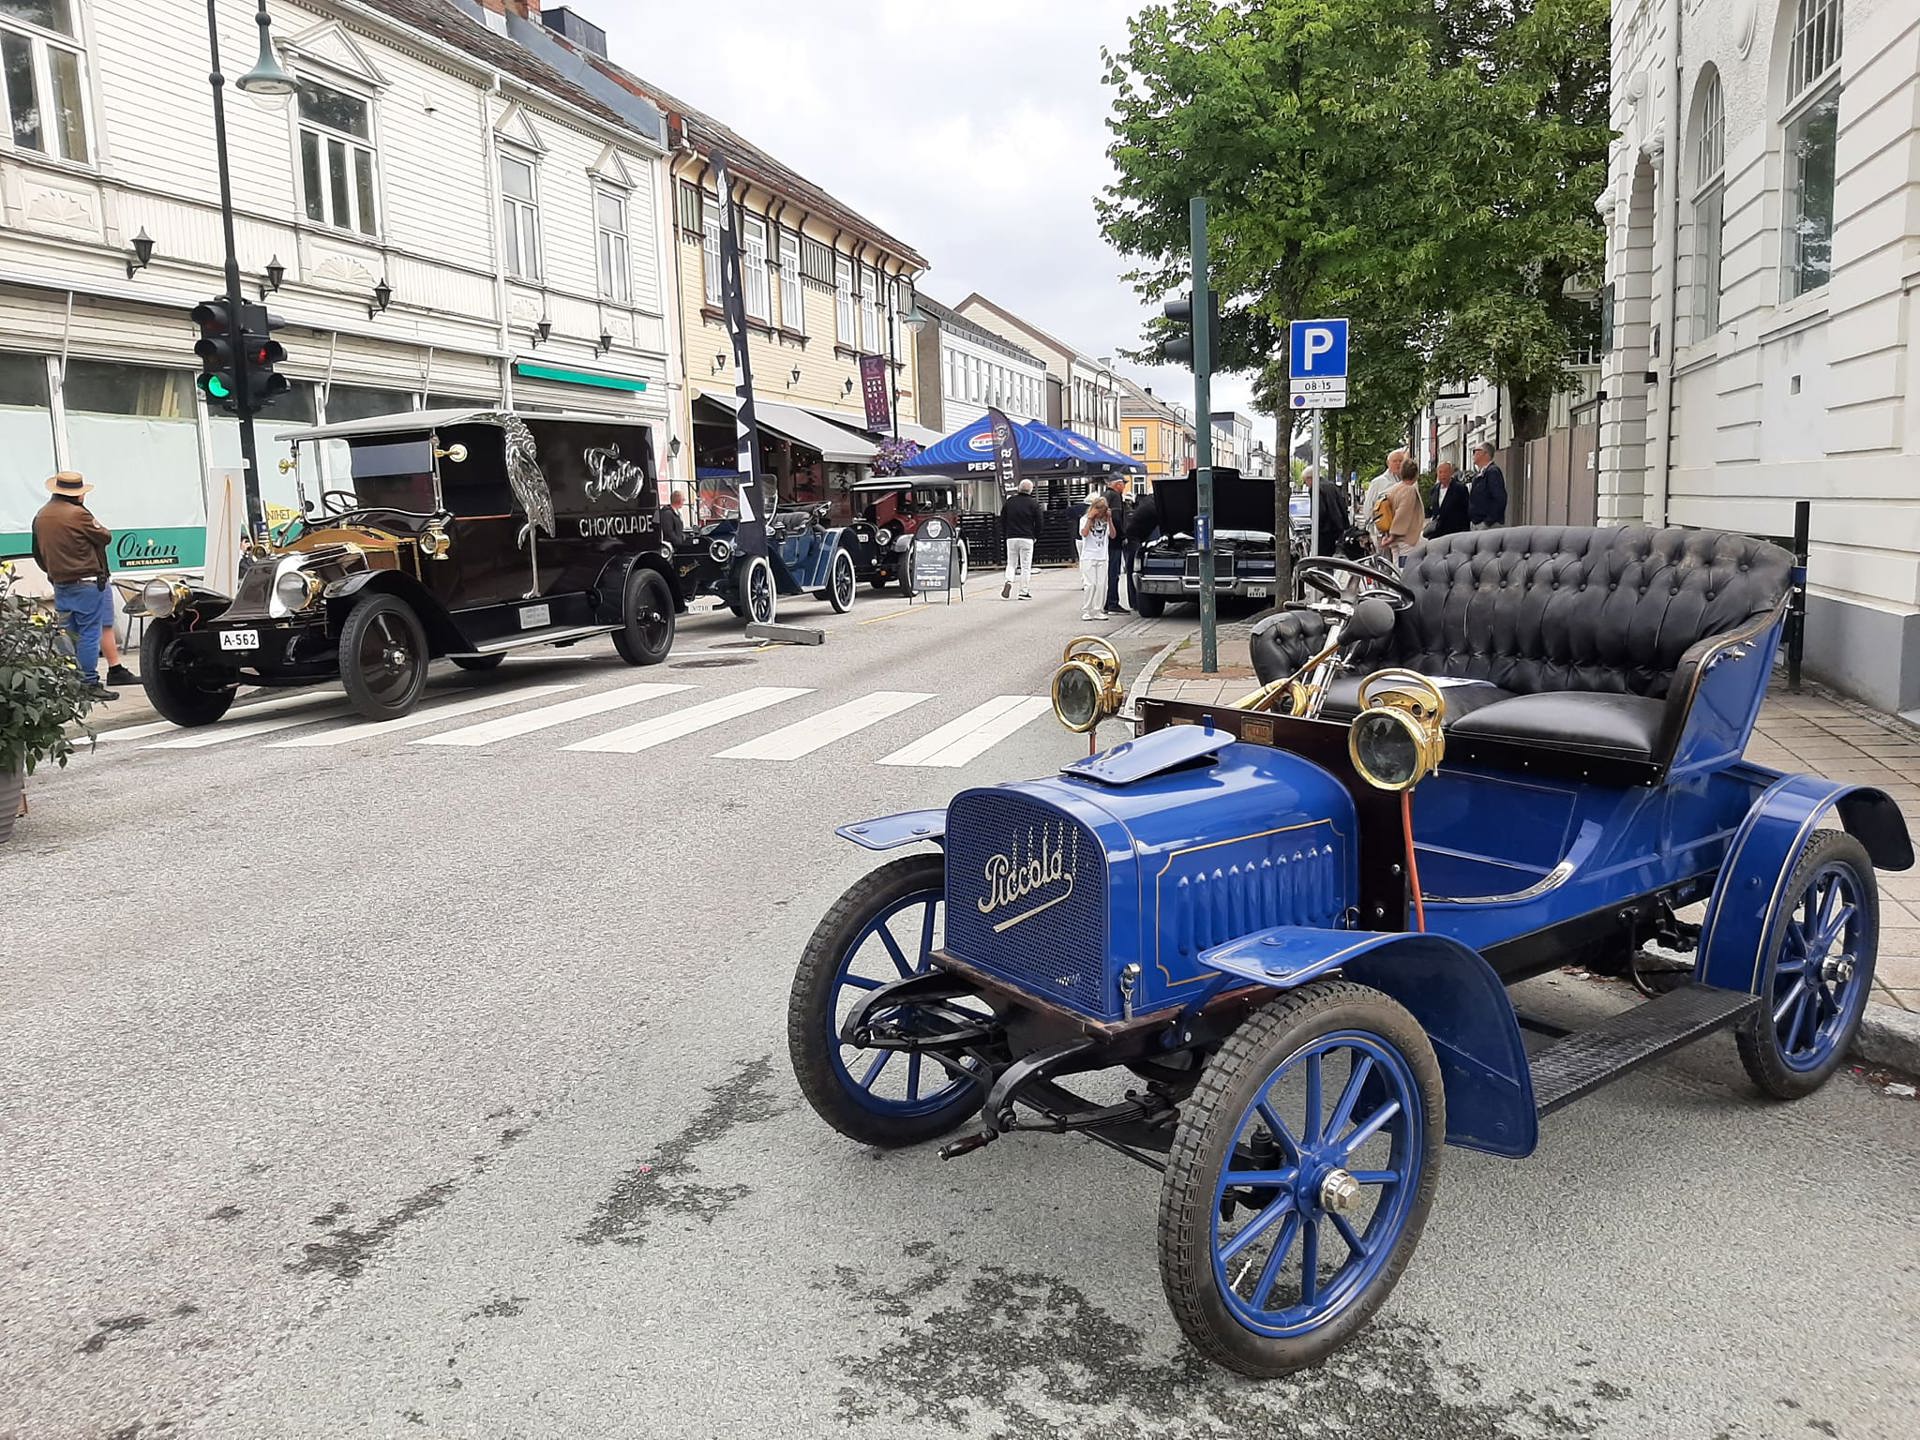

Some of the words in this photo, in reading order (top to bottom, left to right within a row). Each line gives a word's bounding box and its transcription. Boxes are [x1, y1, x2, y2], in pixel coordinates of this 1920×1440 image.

[1304, 328, 1334, 370] P
[967, 461, 997, 472] PEPS
[579, 514, 654, 537] CHOKOLADE
[117, 532, 177, 558] Orion
[223, 633, 257, 646] A-562
